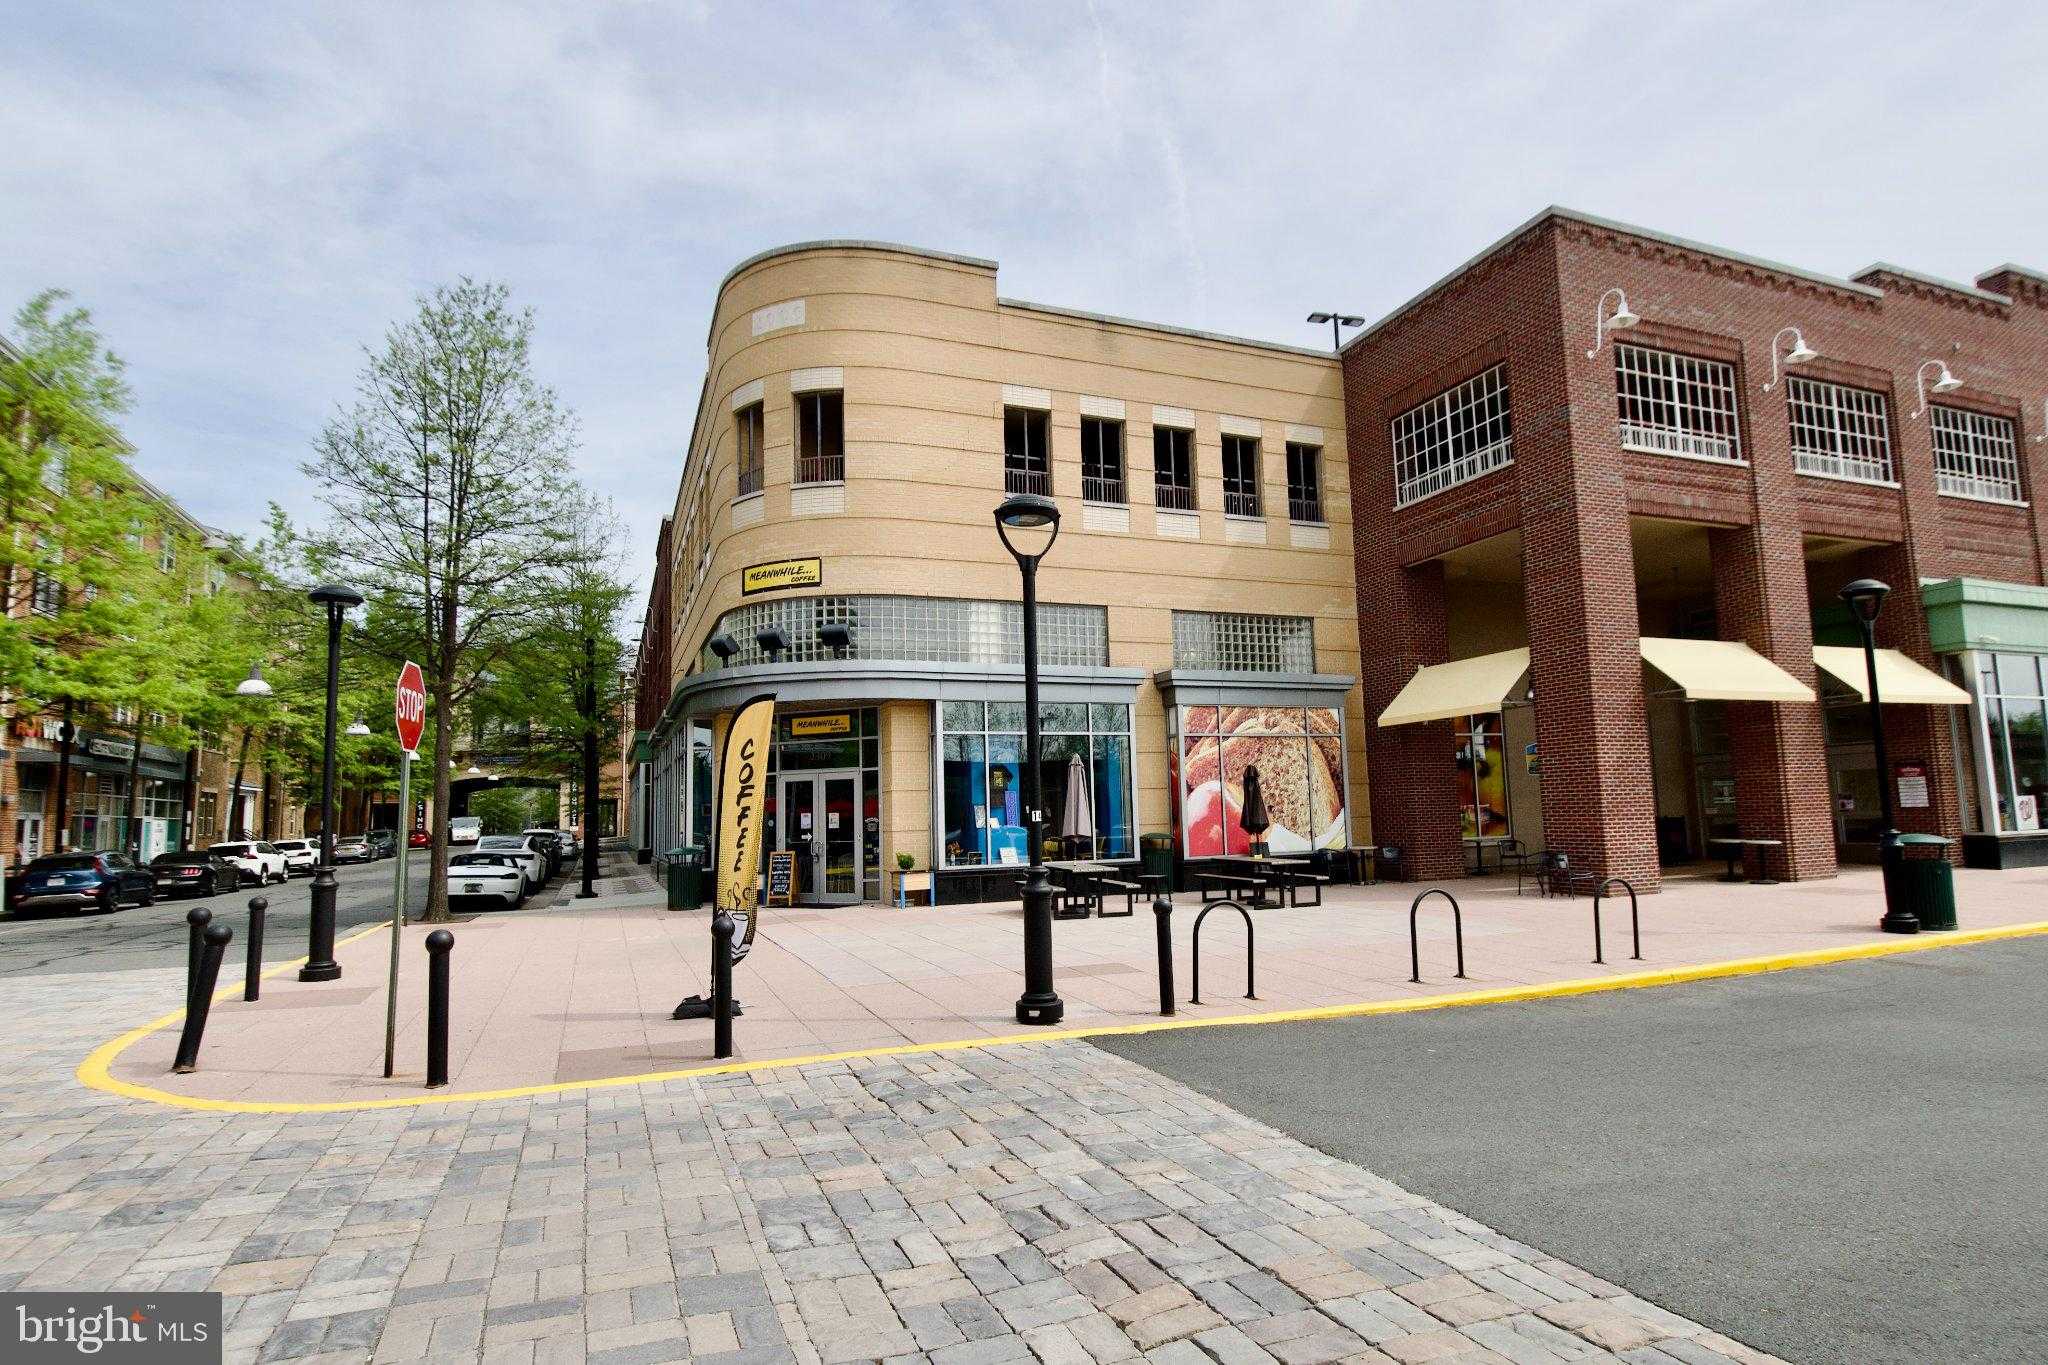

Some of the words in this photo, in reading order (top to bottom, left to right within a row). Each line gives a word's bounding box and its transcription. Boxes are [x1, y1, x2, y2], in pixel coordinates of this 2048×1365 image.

[790, 575, 816, 583] COFFEE
[399, 686, 424, 723] STOP
[733, 738, 756, 872] COFFEE
